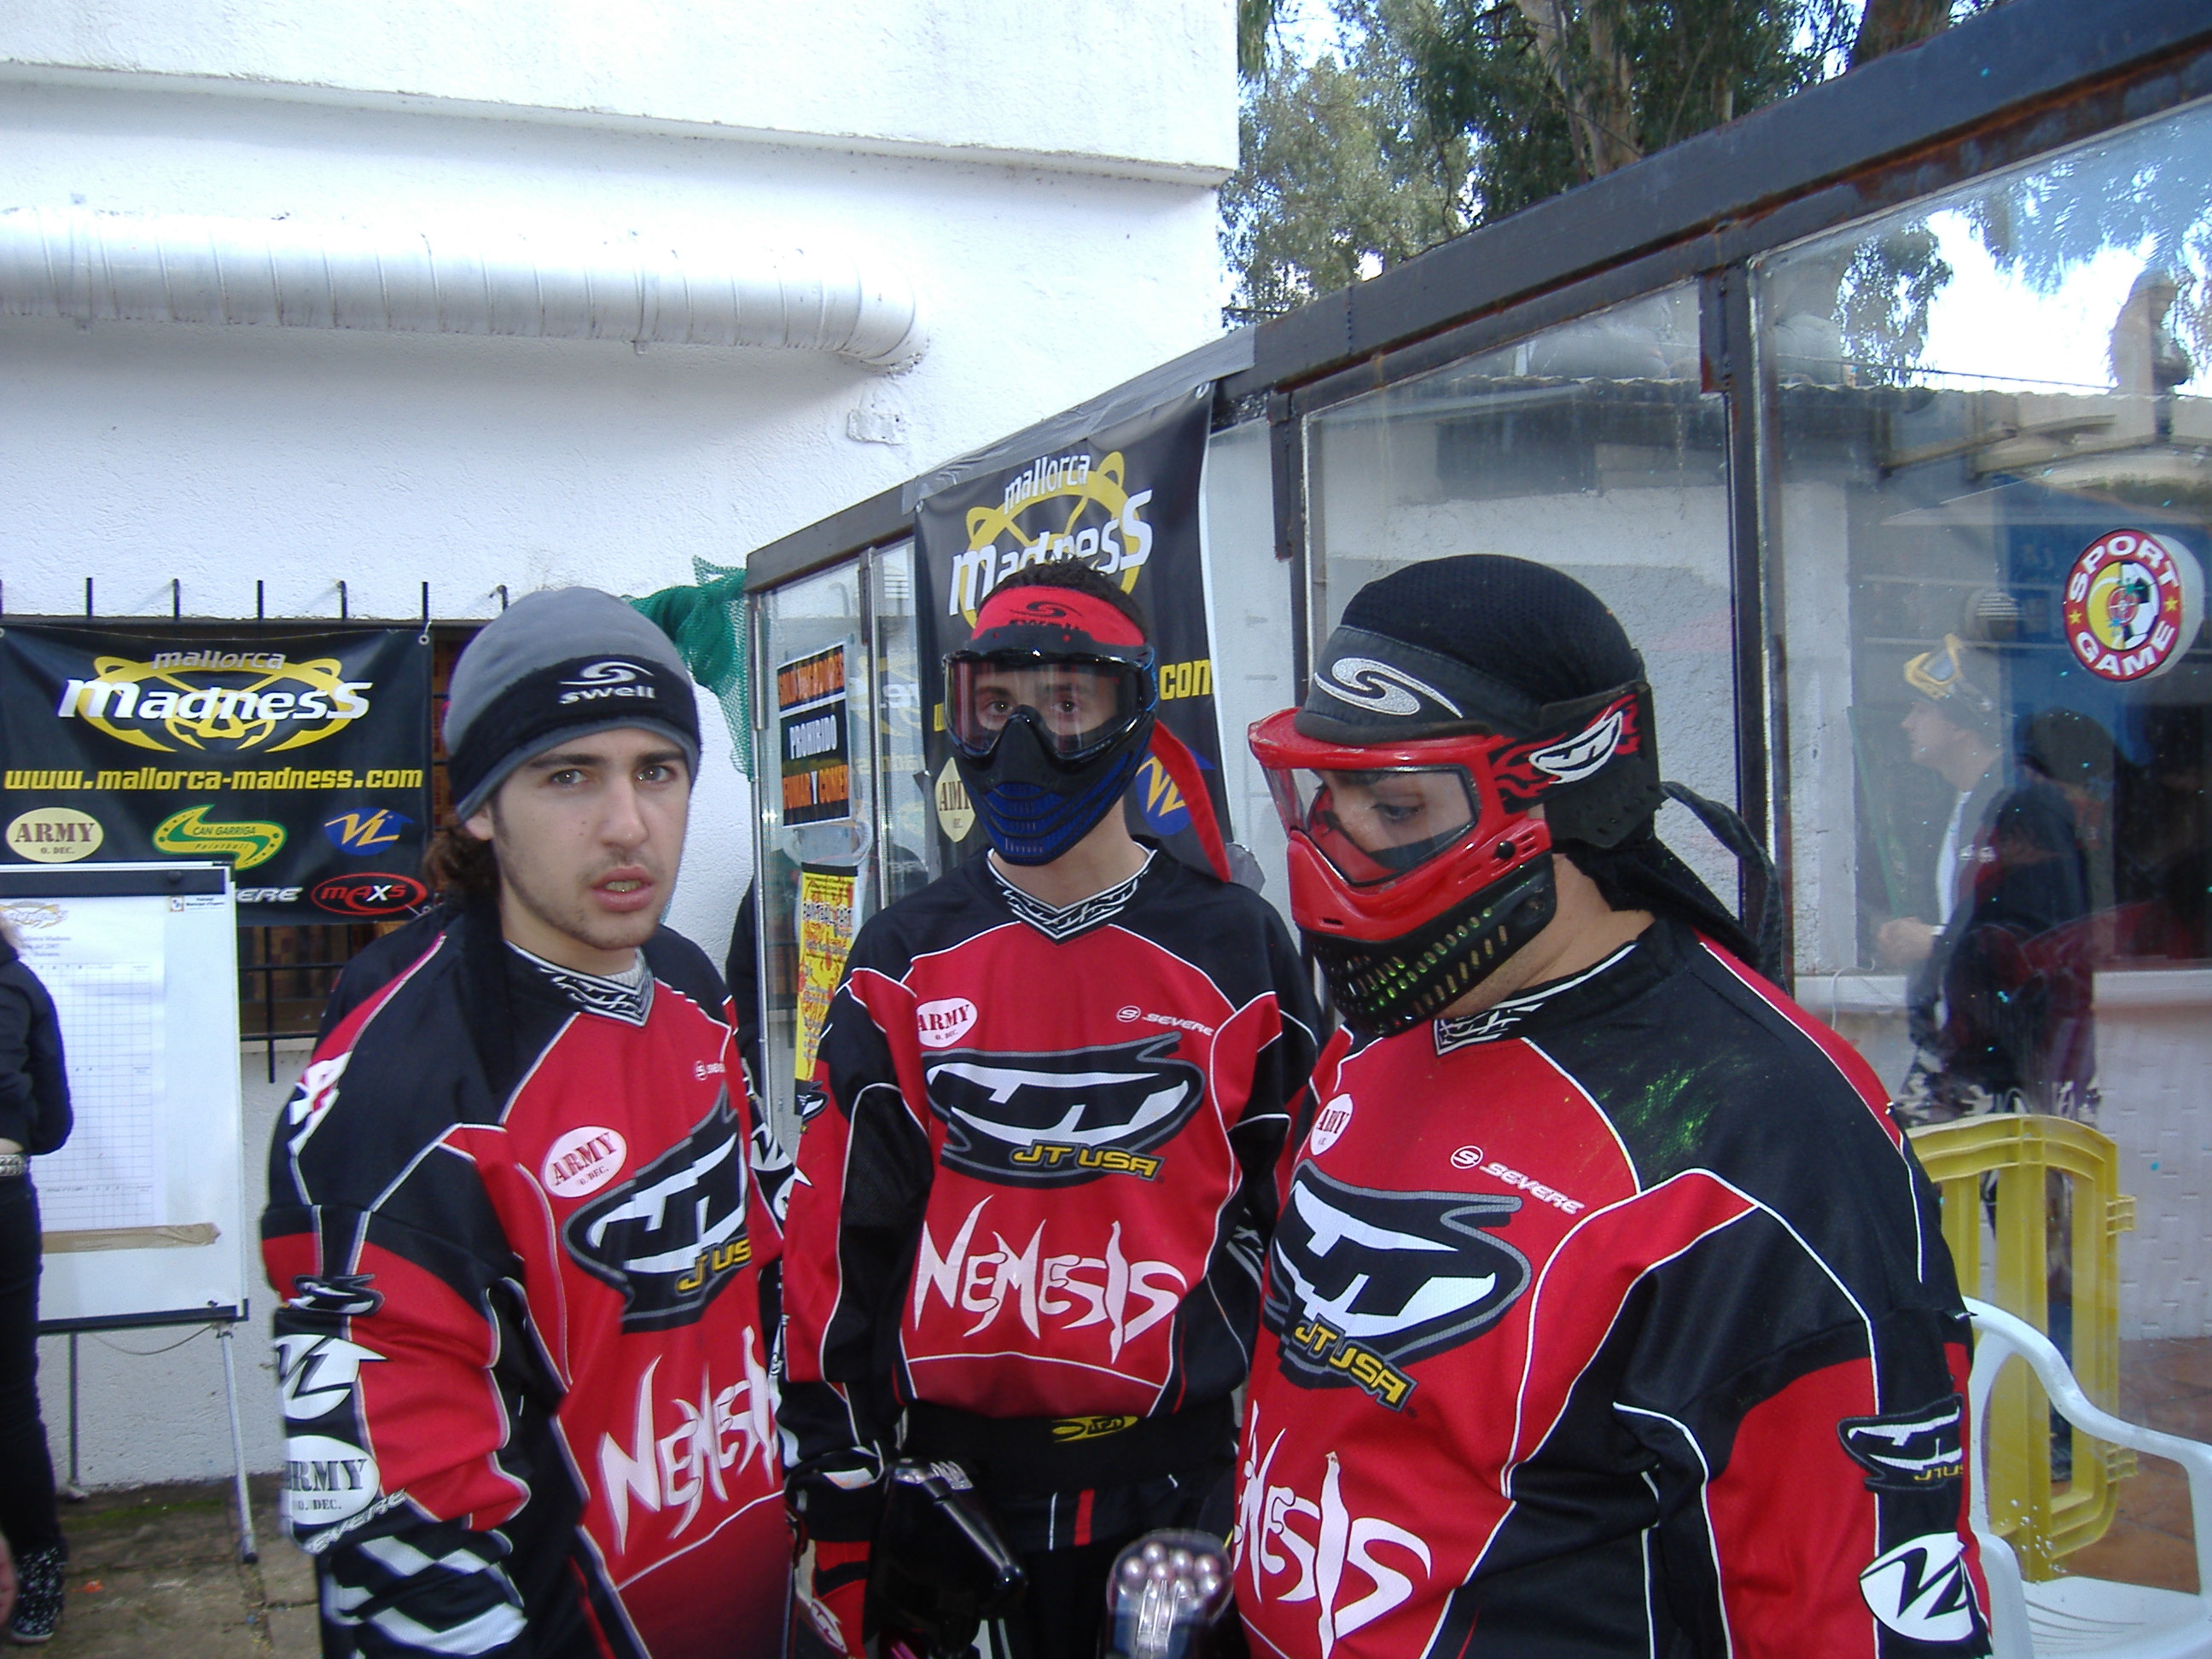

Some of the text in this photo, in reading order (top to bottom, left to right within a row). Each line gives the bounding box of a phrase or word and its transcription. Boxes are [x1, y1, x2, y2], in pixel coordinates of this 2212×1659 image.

[1004, 453, 1091, 515] mallorca
[2069, 535, 2180, 602] SPORT
[151, 649, 287, 671] mallorca
[2075, 620, 2175, 676] GAME
[559, 685, 655, 705] swell
[3, 766, 422, 790] www.mallorca-madness.com
[15, 822, 94, 843] ARMY
[193, 826, 256, 835] CAN GARRIGA
[918, 1004, 969, 1031] ARMY
[1143, 1013, 1214, 1036] SEVERE
[553, 1132, 617, 1185] ARMY
[1012, 1144, 1160, 1178] JT USA
[1480, 1161, 1585, 1214] SEVERE
[712, 1238, 752, 1272] US
[913, 1195, 1187, 1365] NEMESIS
[1295, 1322, 1406, 1404] JT USA
[600, 1325, 778, 1556] NEMESI
[287, 1458, 368, 1491] RMY
[313, 1499, 342, 1511] DEC.
[1233, 1400, 1431, 1658] MESIS
